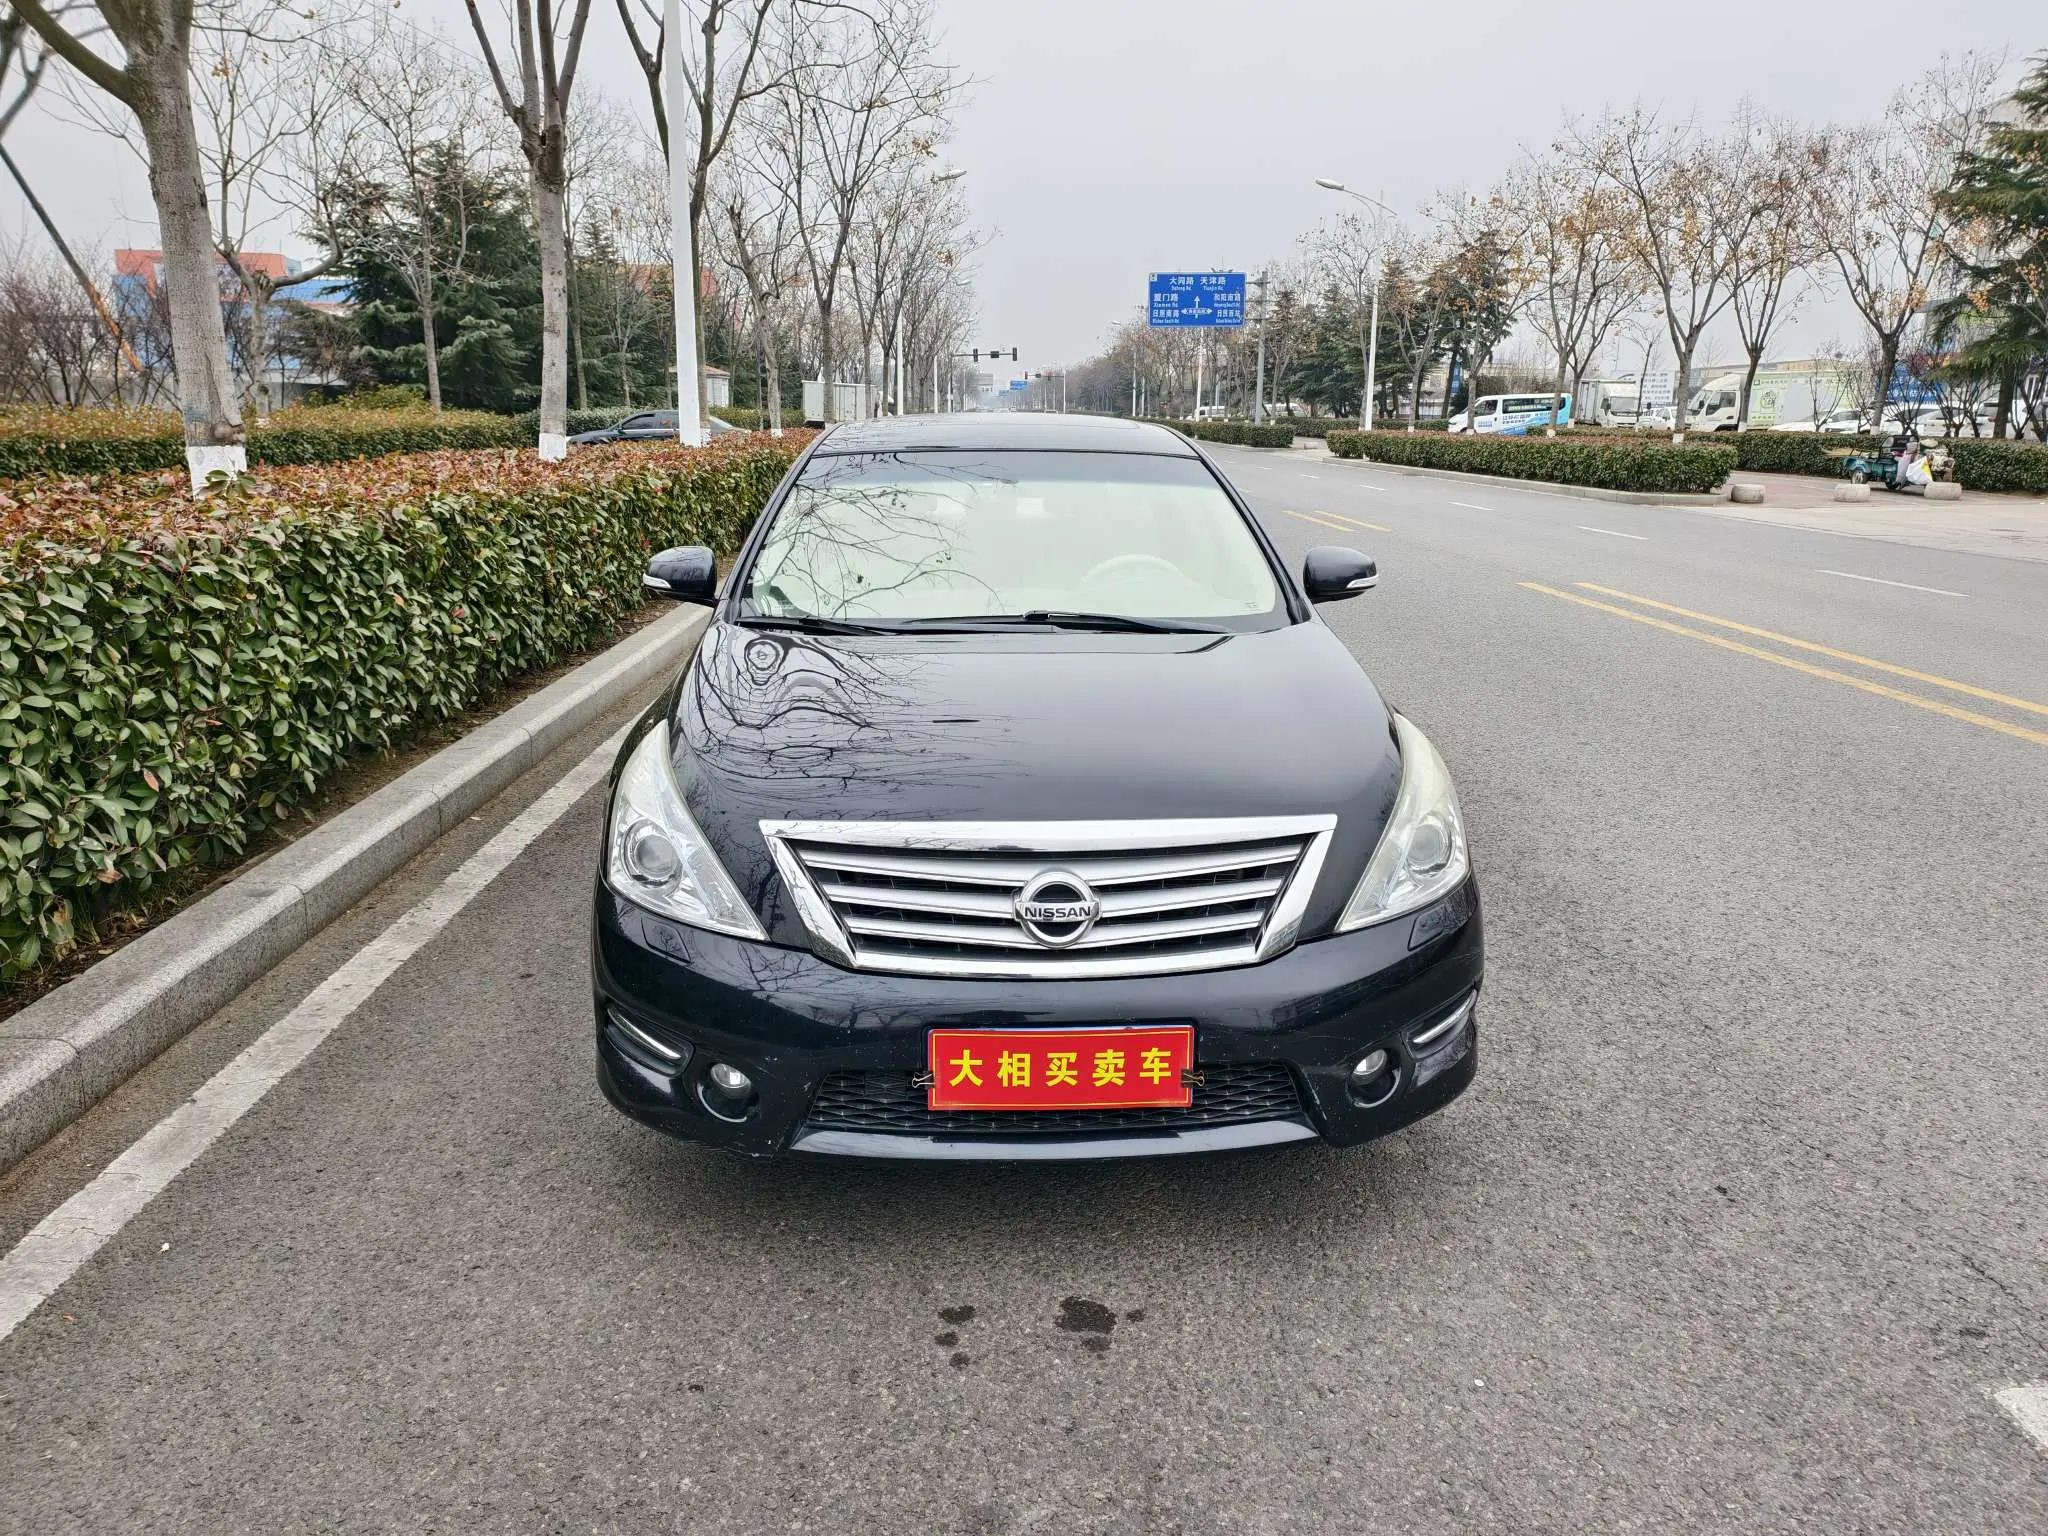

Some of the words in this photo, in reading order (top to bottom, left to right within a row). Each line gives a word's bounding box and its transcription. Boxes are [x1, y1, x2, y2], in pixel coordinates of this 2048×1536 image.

[1200, 276, 1226, 285] 天津路
[1024, 906, 1091, 918] NISSAN
[948, 1047, 1173, 1087] 大相买卖车
